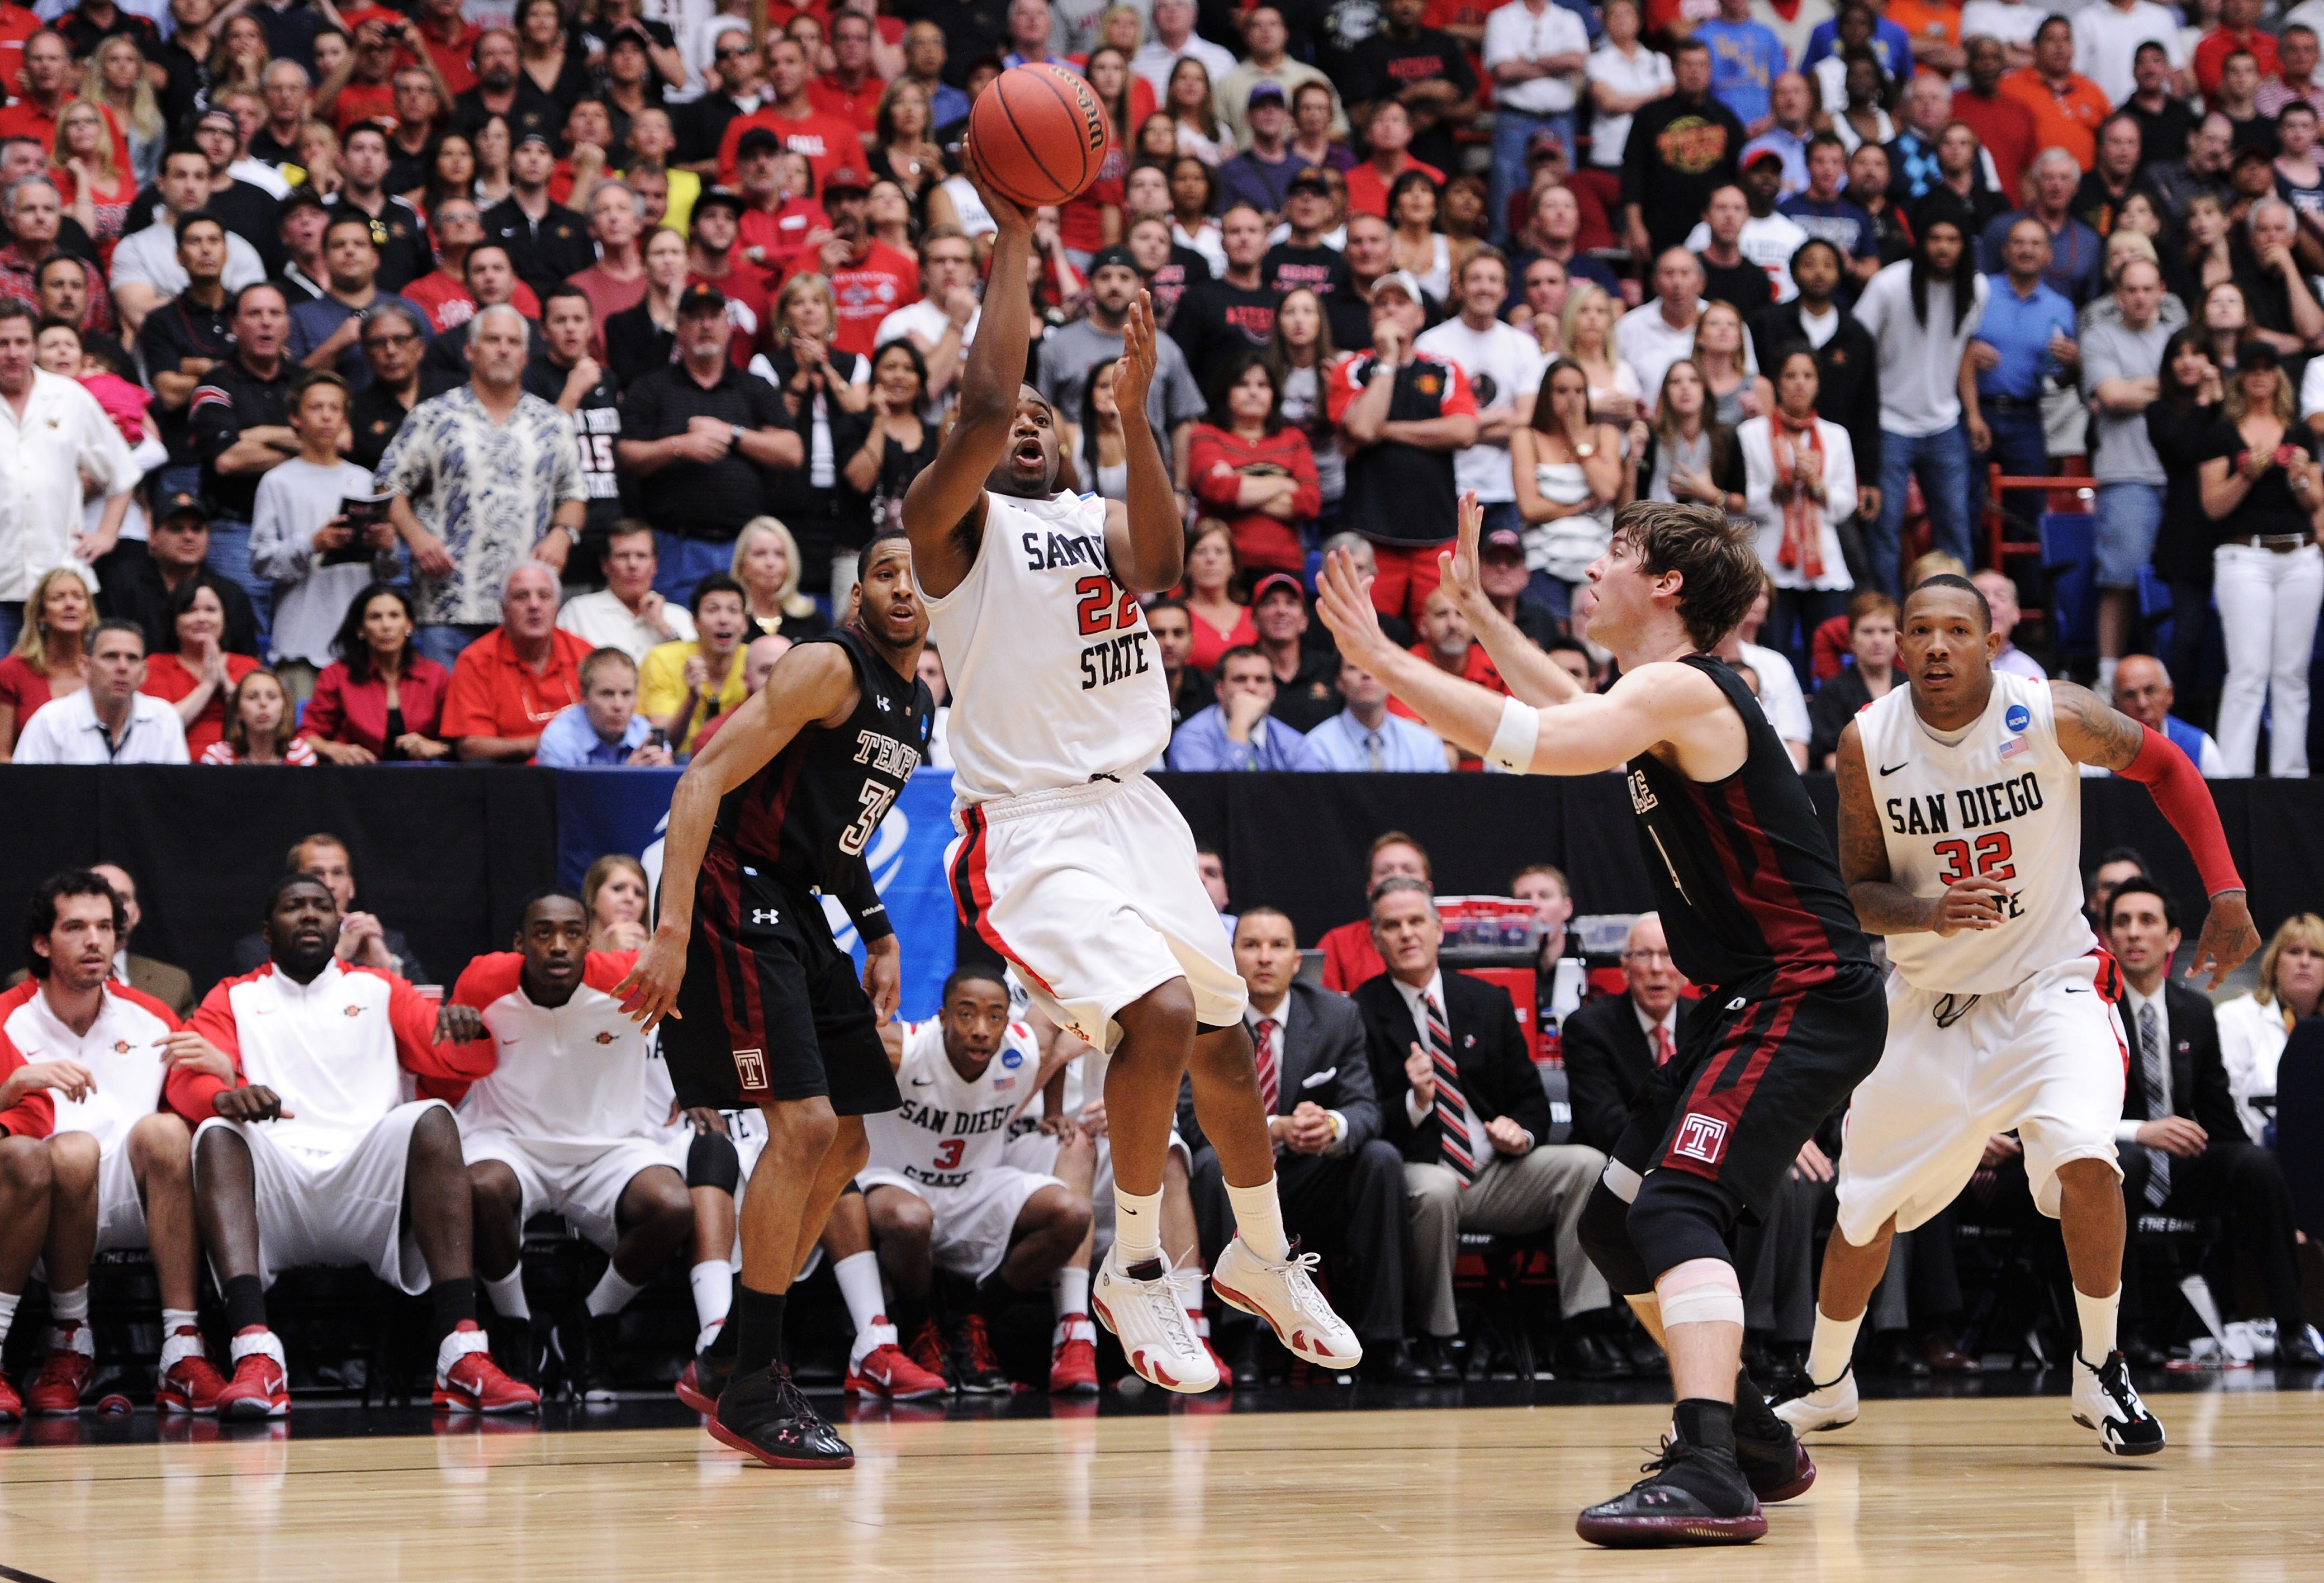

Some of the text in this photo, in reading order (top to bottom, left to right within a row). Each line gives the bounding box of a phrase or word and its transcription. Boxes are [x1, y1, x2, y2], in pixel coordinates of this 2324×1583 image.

[577, 434, 614, 472] 15
[1075, 575, 1138, 636] 22
[1080, 631, 1149, 690] STATE
[853, 729, 922, 783] TEMPL
[1886, 771, 2044, 835] SAN DIEGO
[1933, 831, 2017, 886] 32
[899, 1099, 950, 1134] SAN
[954, 1103, 1015, 1135] DIEG
[933, 1139, 965, 1170] 3
